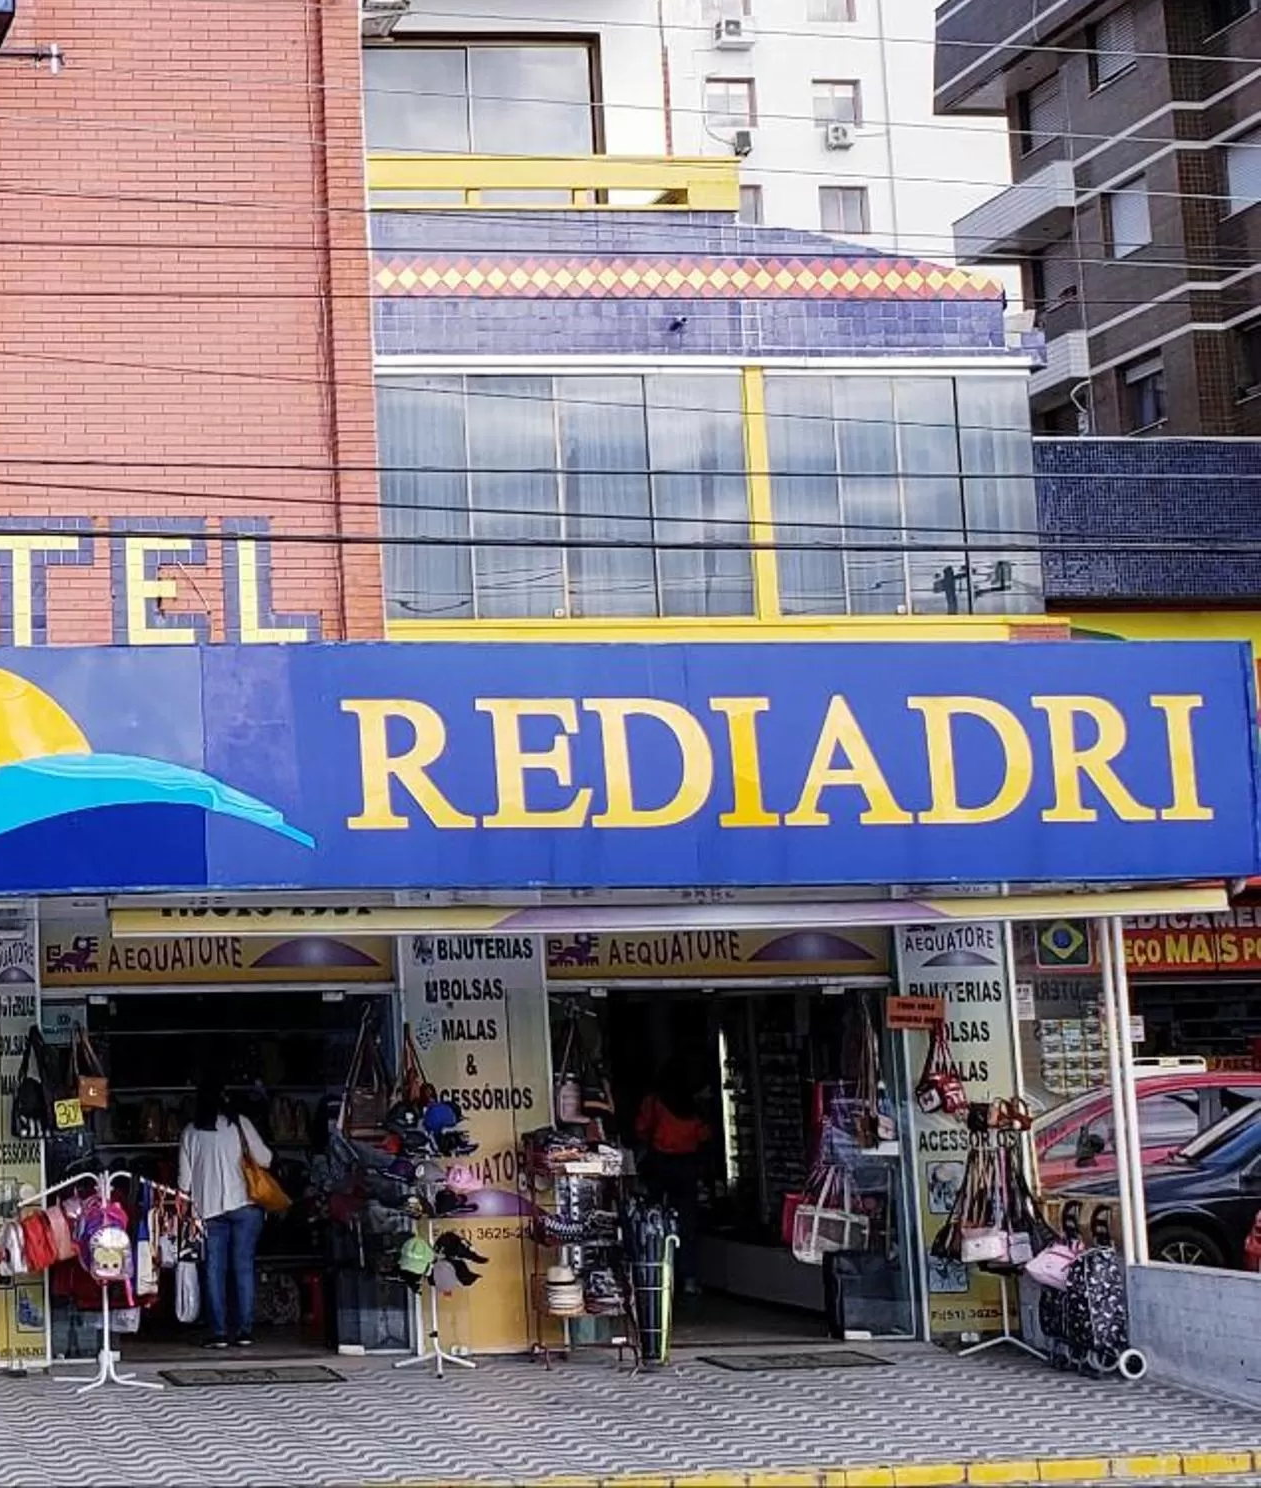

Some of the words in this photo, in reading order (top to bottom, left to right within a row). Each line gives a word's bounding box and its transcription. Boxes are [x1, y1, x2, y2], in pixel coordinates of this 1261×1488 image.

[340, 694, 1214, 830] REDIADRI
[1122, 908, 1261, 929] EDICAME
[437, 937, 534, 961] BIJUTERIAS
[608, 929, 743, 966] AEQUATORE
[905, 926, 995, 953] AEQUATORE
[1123, 939, 1161, 967] EÇO
[1165, 933, 1239, 964] MAIS
[109, 933, 244, 972] AEQUATORE
[439, 978, 504, 1001] BOLSAS
[441, 1018, 498, 1041] MALAS
[946, 1021, 991, 1043] LSAS
[466, 1053, 478, 1076] &
[439, 1083, 534, 1110] CESSÓRIOS
[919, 1129, 1018, 1151] ACESSOROS
